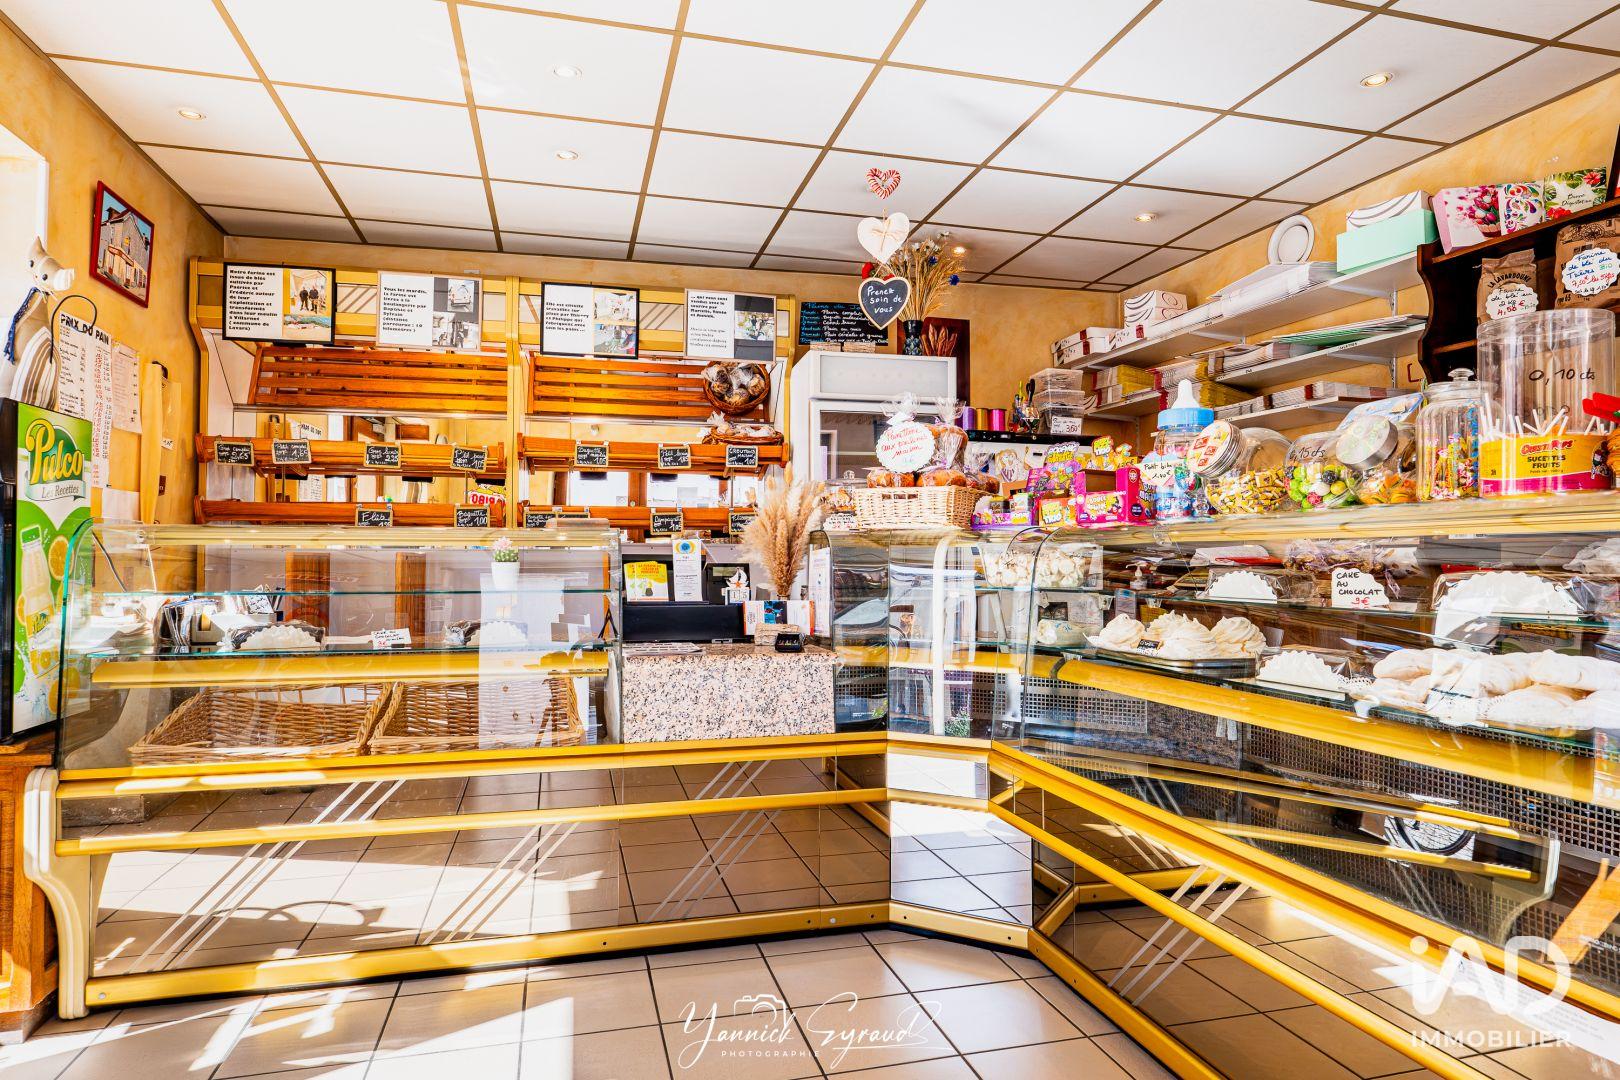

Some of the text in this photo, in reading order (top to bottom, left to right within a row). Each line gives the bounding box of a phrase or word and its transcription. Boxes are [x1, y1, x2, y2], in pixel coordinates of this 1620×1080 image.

[893, 294, 902, 302] de
[60, 314, 79, 330] PRIX
[95, 330, 110, 345] PAIN
[26, 418, 83, 485] Pulco
[55, 484, 79, 497] Recettes
